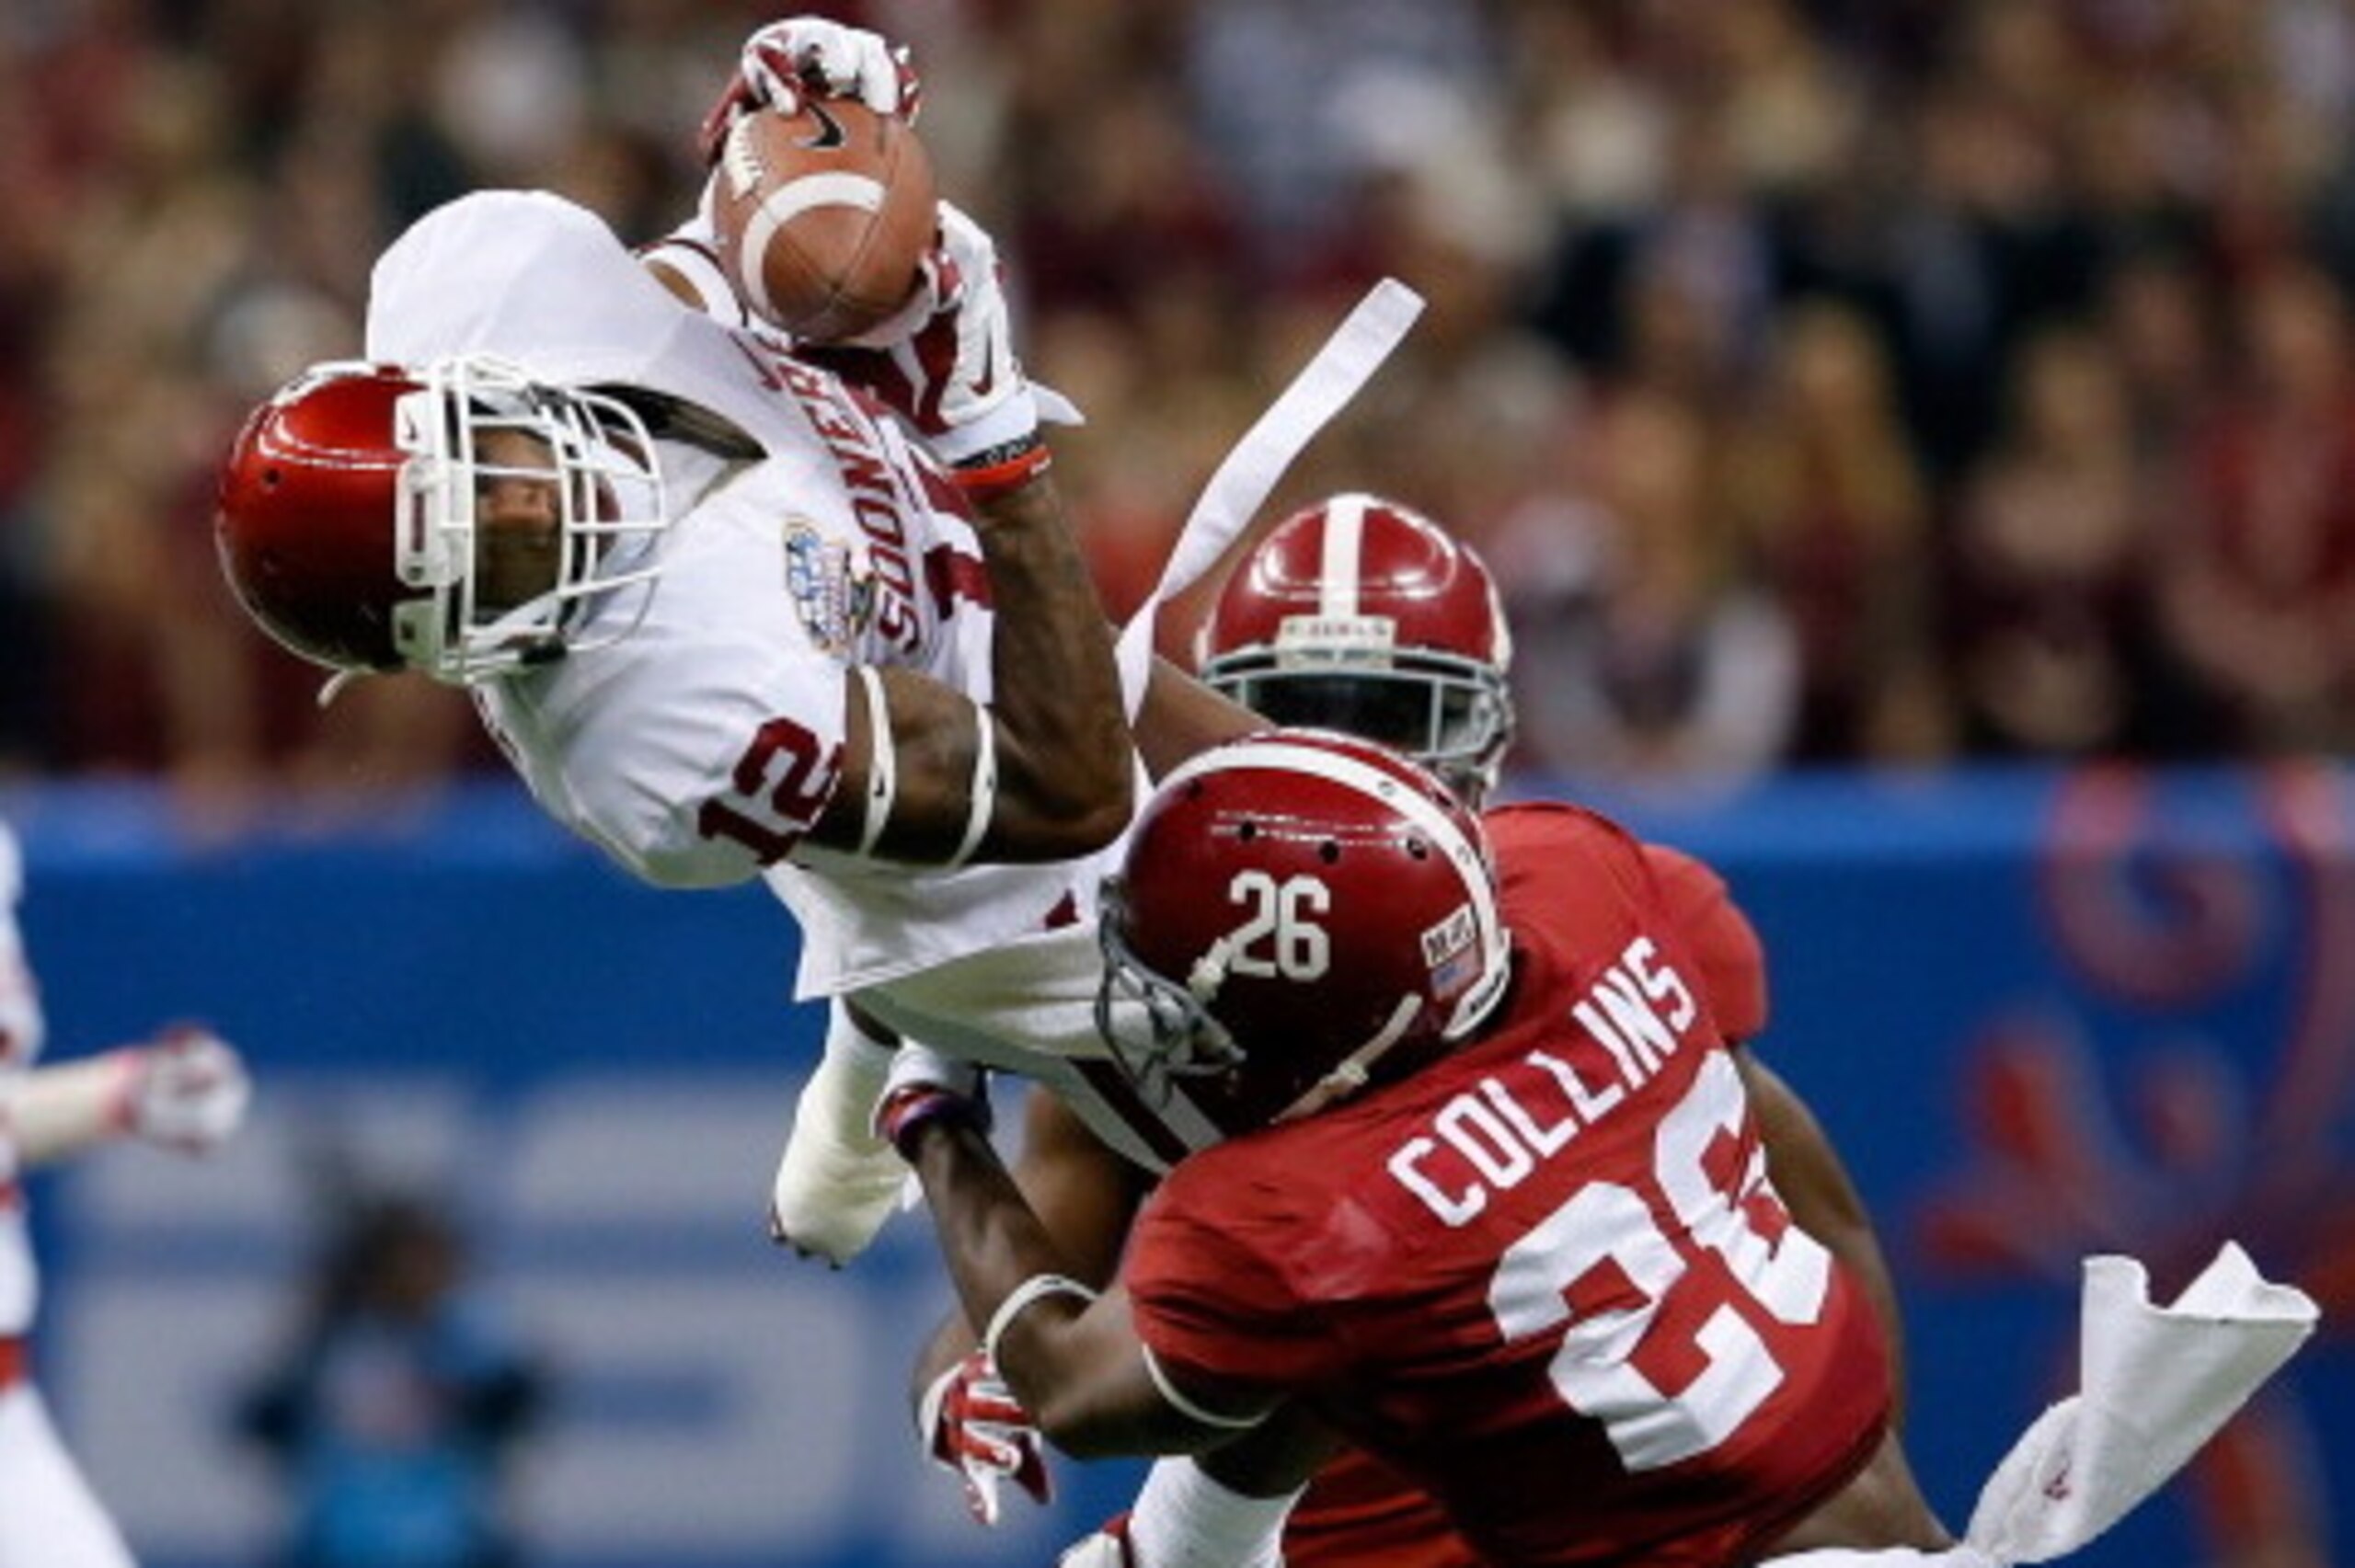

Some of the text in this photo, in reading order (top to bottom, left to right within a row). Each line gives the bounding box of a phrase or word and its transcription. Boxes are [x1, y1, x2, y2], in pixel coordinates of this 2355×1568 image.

[699, 717, 843, 867] 12
[1230, 870, 1330, 980] 26
[1386, 936, 1696, 1226] COLLINS
[1487, 1049, 1832, 1471] 26
